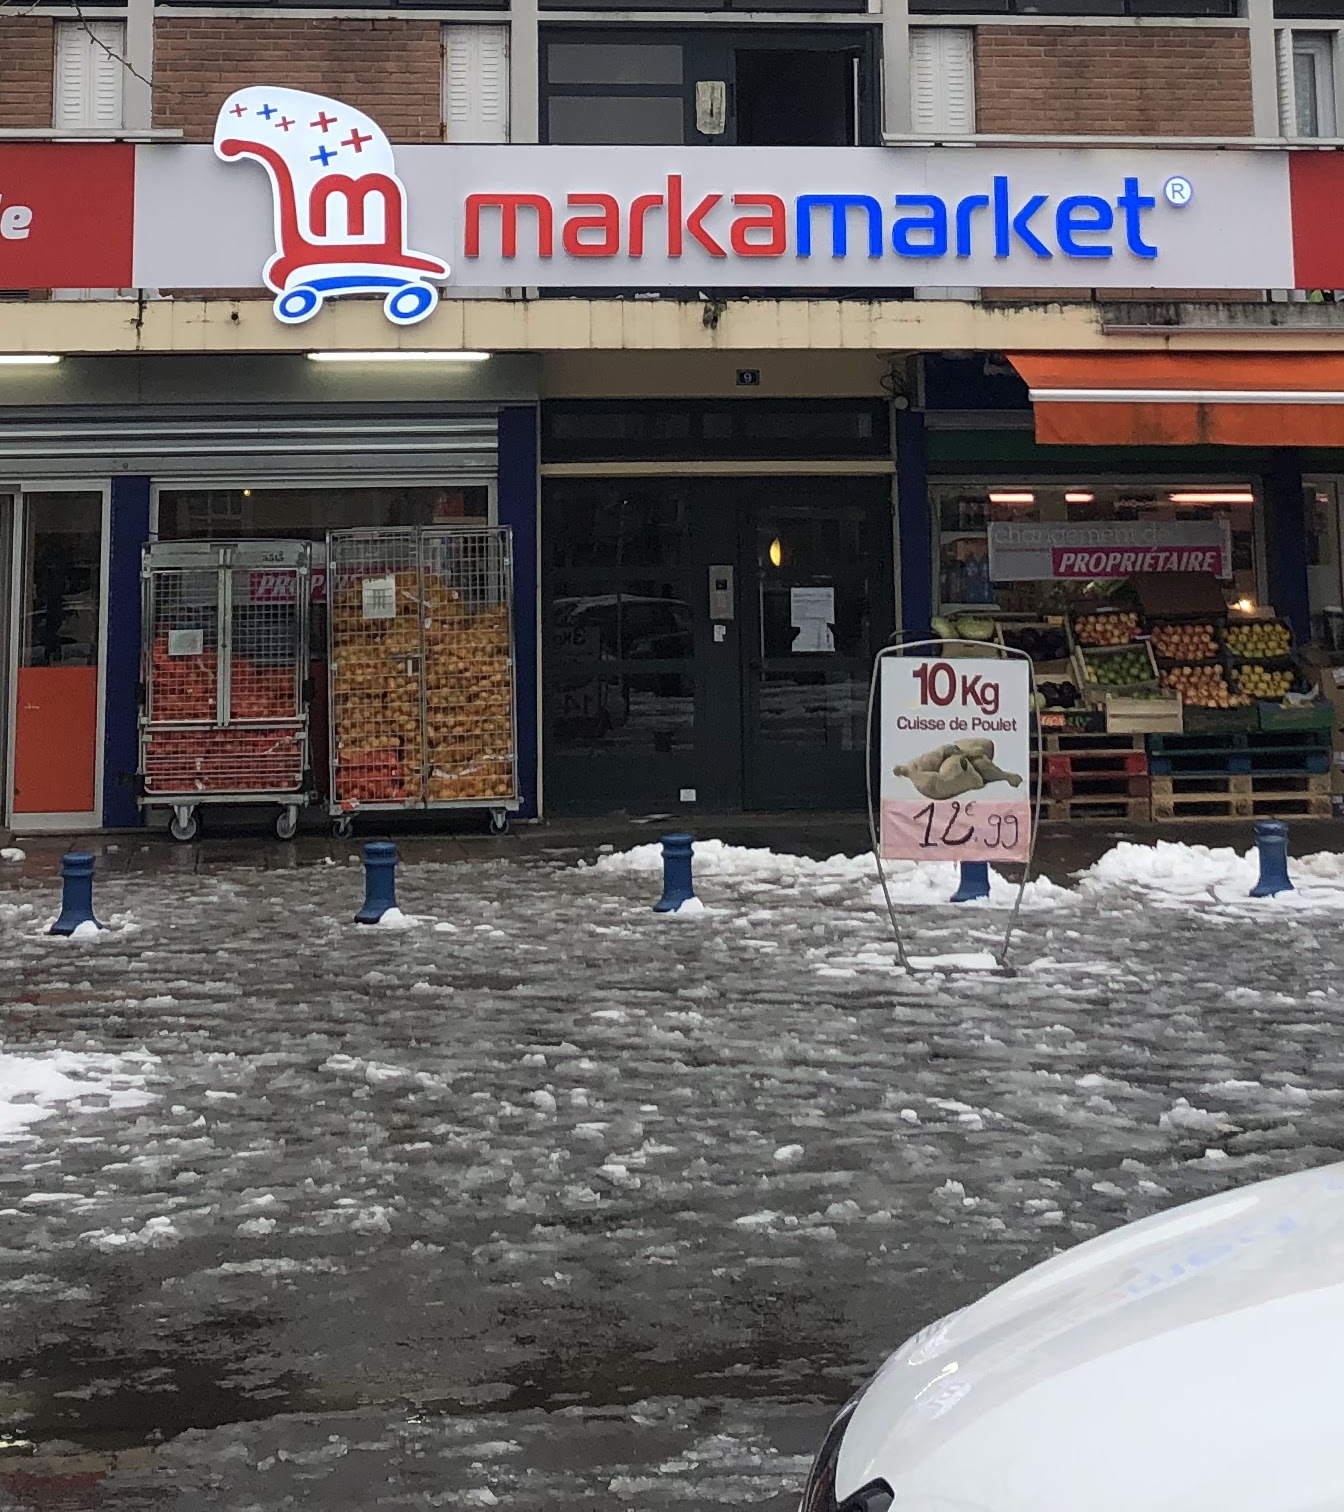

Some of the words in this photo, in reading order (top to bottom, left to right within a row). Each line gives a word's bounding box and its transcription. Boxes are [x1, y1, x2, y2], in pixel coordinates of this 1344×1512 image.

[463, 175, 1159, 259] markamarket
[743, 372, 753, 384] 9
[1058, 545, 1217, 573] PROPRIÉTAIRE
[912, 662, 956, 706] 10
[960, 674, 1000, 715] Kg
[896, 716, 946, 730] Cuisse
[949, 716, 968, 731] de
[971, 717, 1017, 732] Poulet
